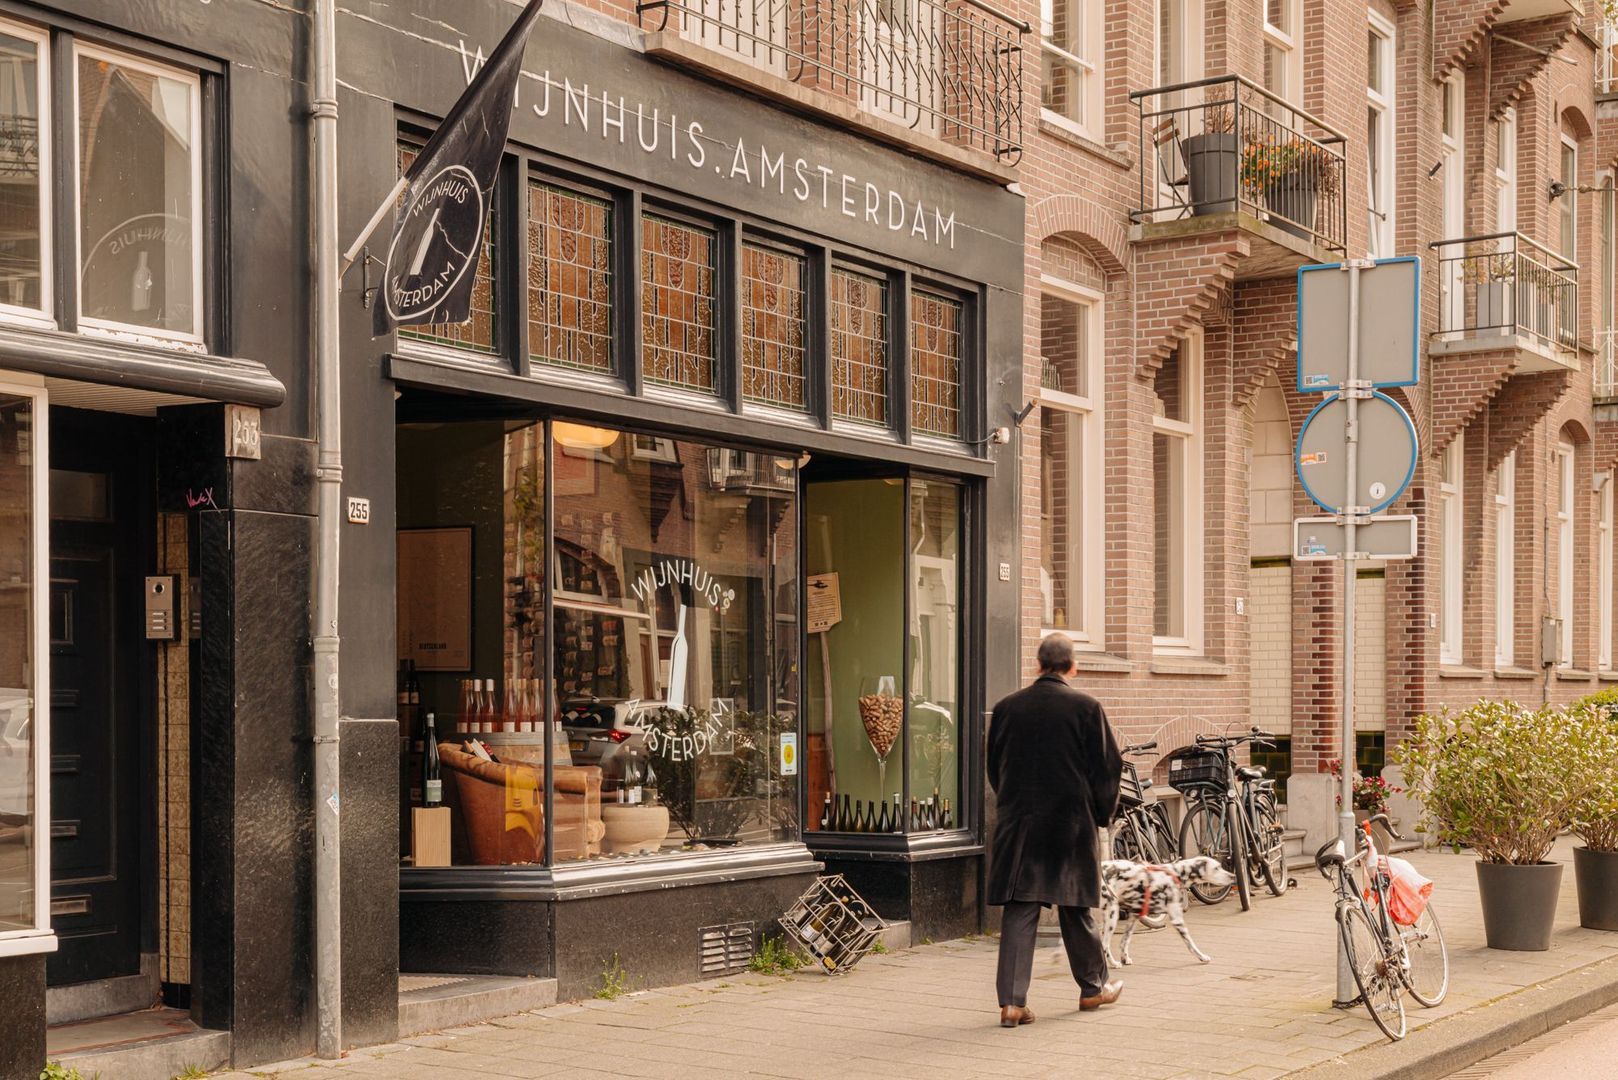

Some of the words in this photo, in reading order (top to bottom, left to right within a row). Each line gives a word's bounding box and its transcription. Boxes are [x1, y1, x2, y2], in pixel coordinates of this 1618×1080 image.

[413, 180, 469, 217] WIJNHUIS
[350, 501, 368, 520] 255
[631, 559, 721, 606] WIJNHUIS
[625, 697, 729, 762] AMSTERDAM
